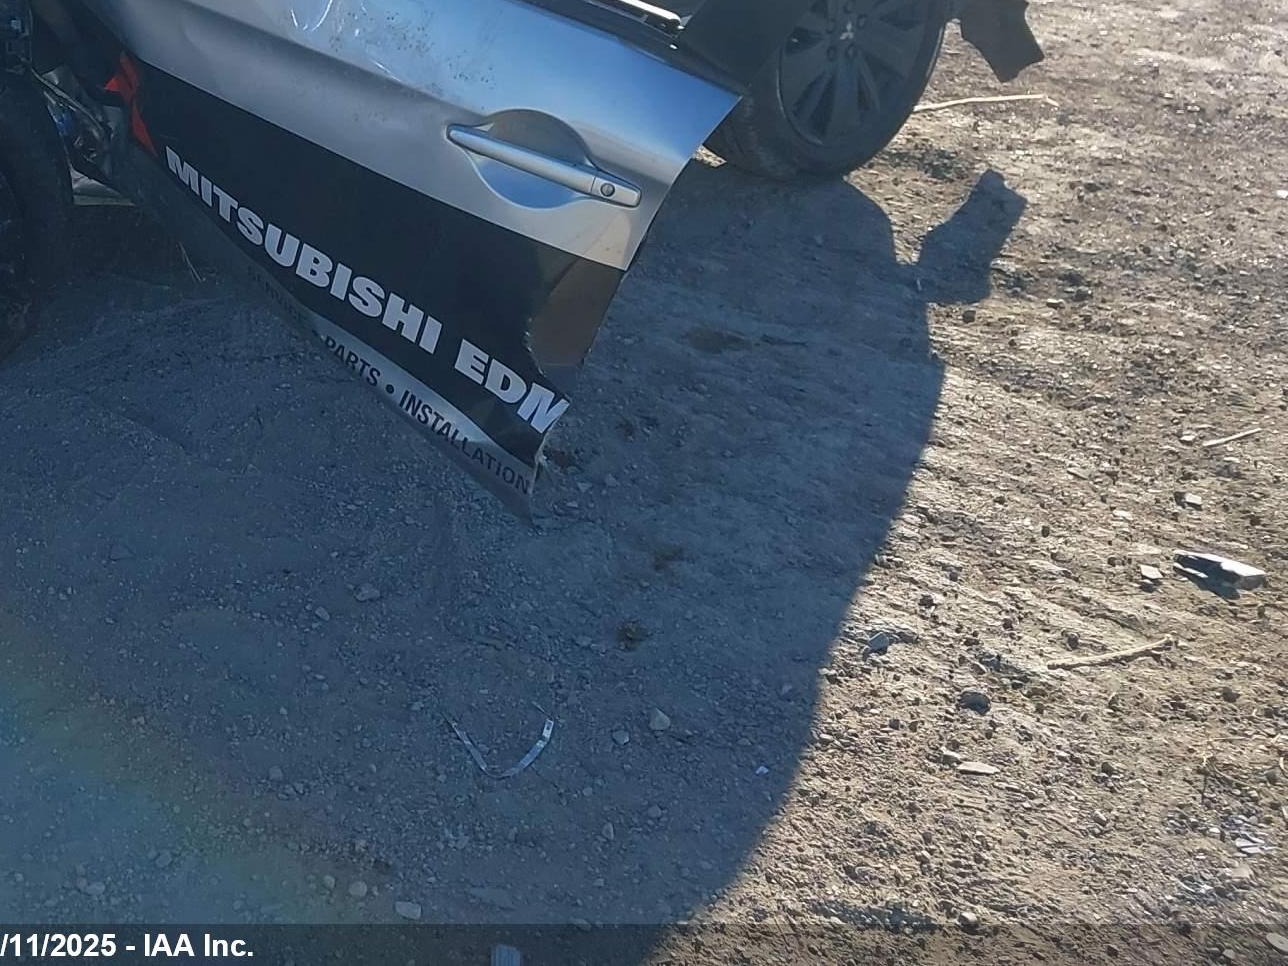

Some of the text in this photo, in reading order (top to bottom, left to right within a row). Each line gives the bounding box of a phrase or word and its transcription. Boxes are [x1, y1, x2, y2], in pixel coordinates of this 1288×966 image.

[165, 145, 443, 355] MITSUBISHI
[323, 335, 532, 495] PARTS INSTALLATION
